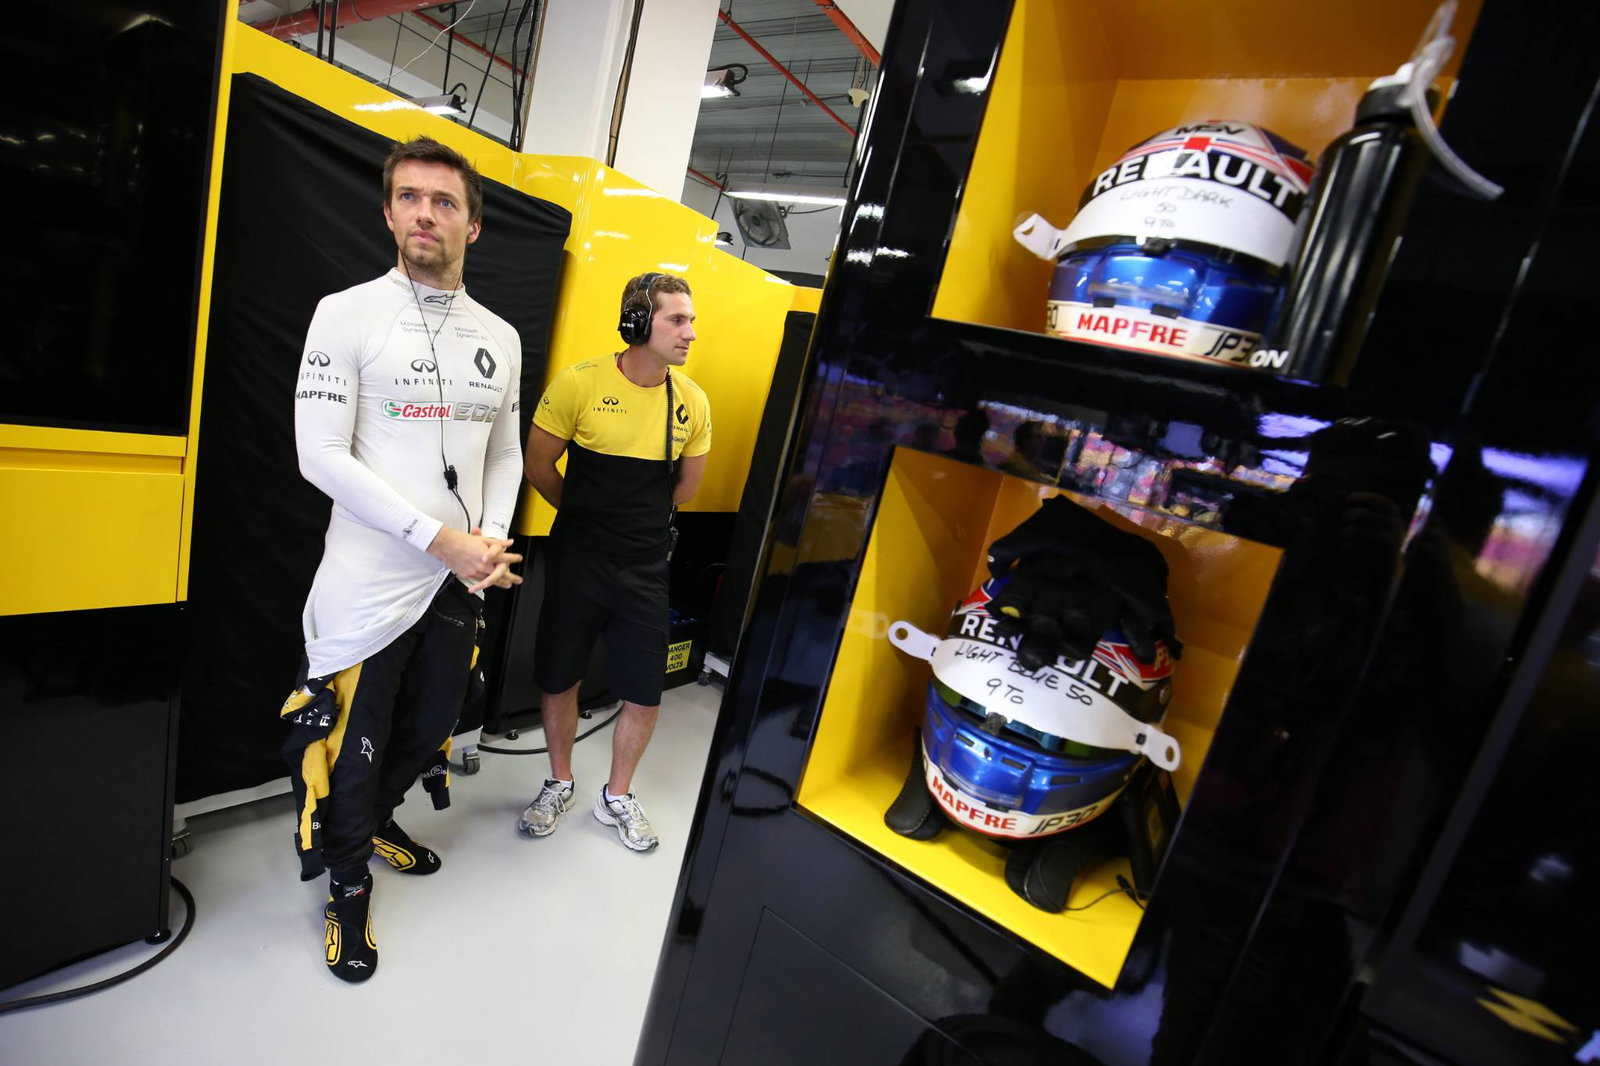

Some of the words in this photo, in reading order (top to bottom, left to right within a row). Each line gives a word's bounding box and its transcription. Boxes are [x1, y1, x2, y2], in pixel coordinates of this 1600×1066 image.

[1179, 187, 1234, 209] DARK
[1077, 312, 1189, 348] MAPFRE
[395, 378, 452, 386] INFINITI
[469, 381, 503, 393] RENAULT
[402, 404, 452, 418] Castrol
[955, 641, 1003, 664] LIGHT
[932, 775, 1018, 831] MAPFRE
